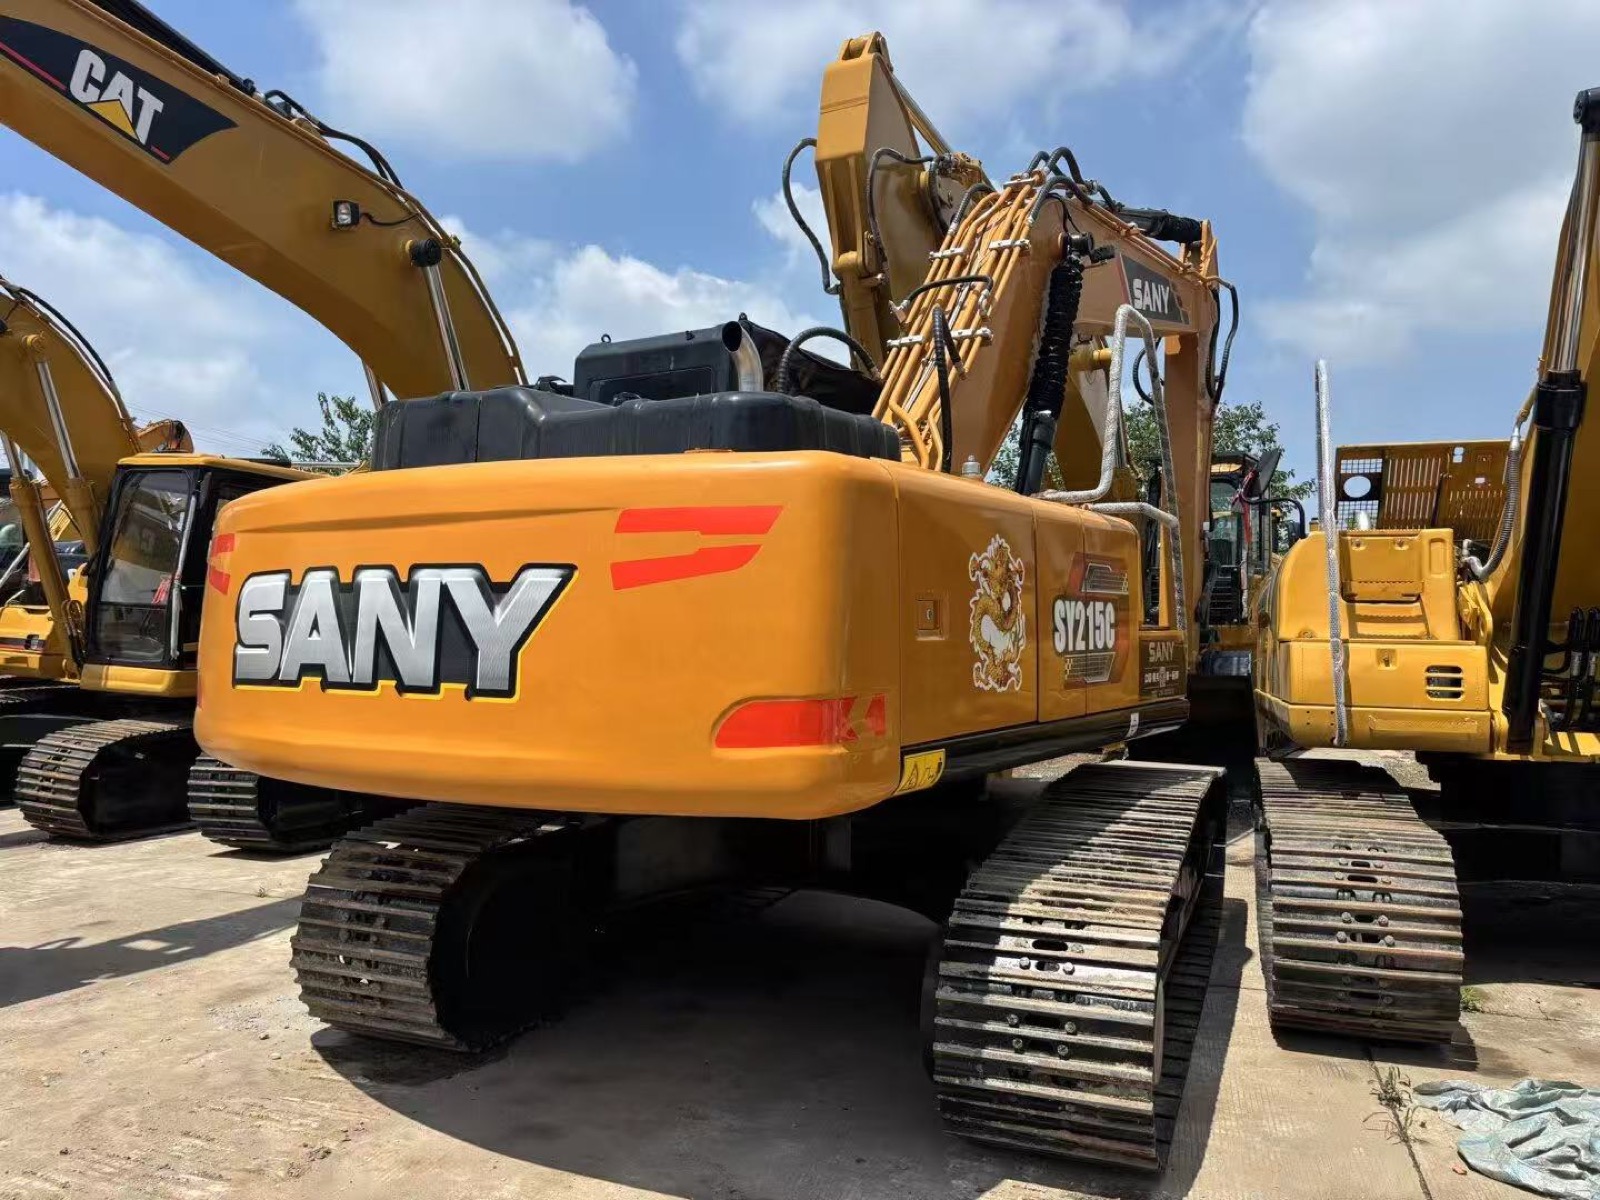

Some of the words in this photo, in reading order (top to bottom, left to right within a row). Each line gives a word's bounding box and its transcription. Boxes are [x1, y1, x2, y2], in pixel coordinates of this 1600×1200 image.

[70, 49, 164, 145] CAT
[1133, 278, 1170, 315] SANY
[233, 564, 575, 701] SANY
[1054, 599, 1115, 653] SY215C
[1149, 641, 1174, 662] SANY
